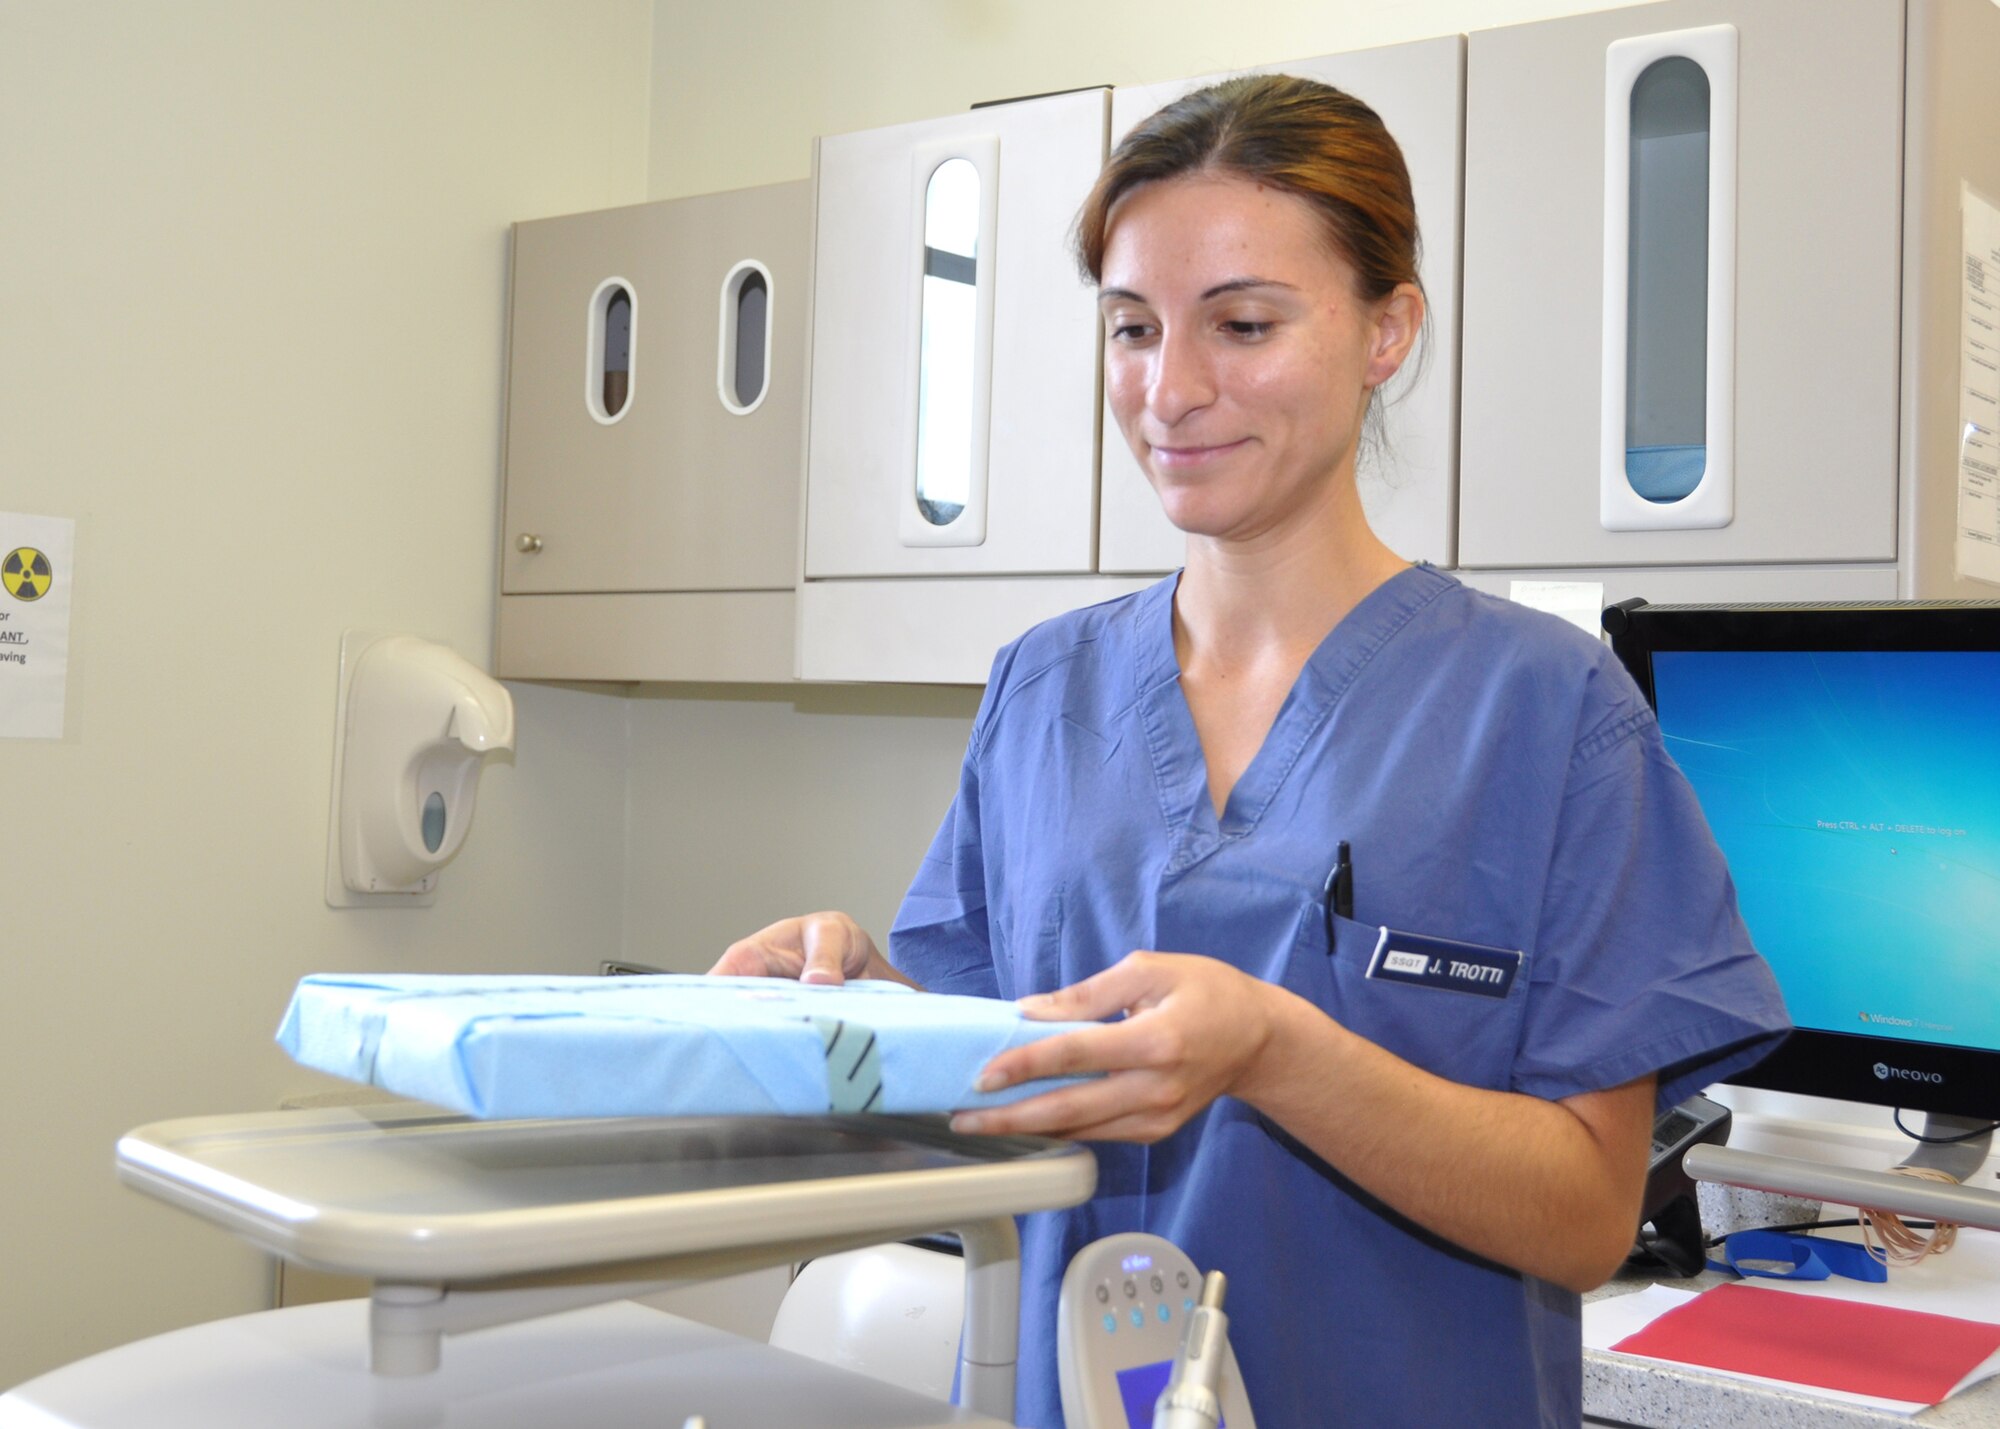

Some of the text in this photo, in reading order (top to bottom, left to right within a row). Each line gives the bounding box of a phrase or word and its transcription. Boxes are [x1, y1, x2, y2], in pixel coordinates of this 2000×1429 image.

[1817, 819, 1837, 829] Press
[1839, 821, 1859, 830] CTRL
[1869, 823, 1885, 831] ALT
[1895, 824, 1925, 834] DELETE
[1390, 956, 1504, 984] SSGT J. TROTTI
[1870, 1013, 1912, 1028] Windows
[1890, 1066, 1942, 1084] neovo
